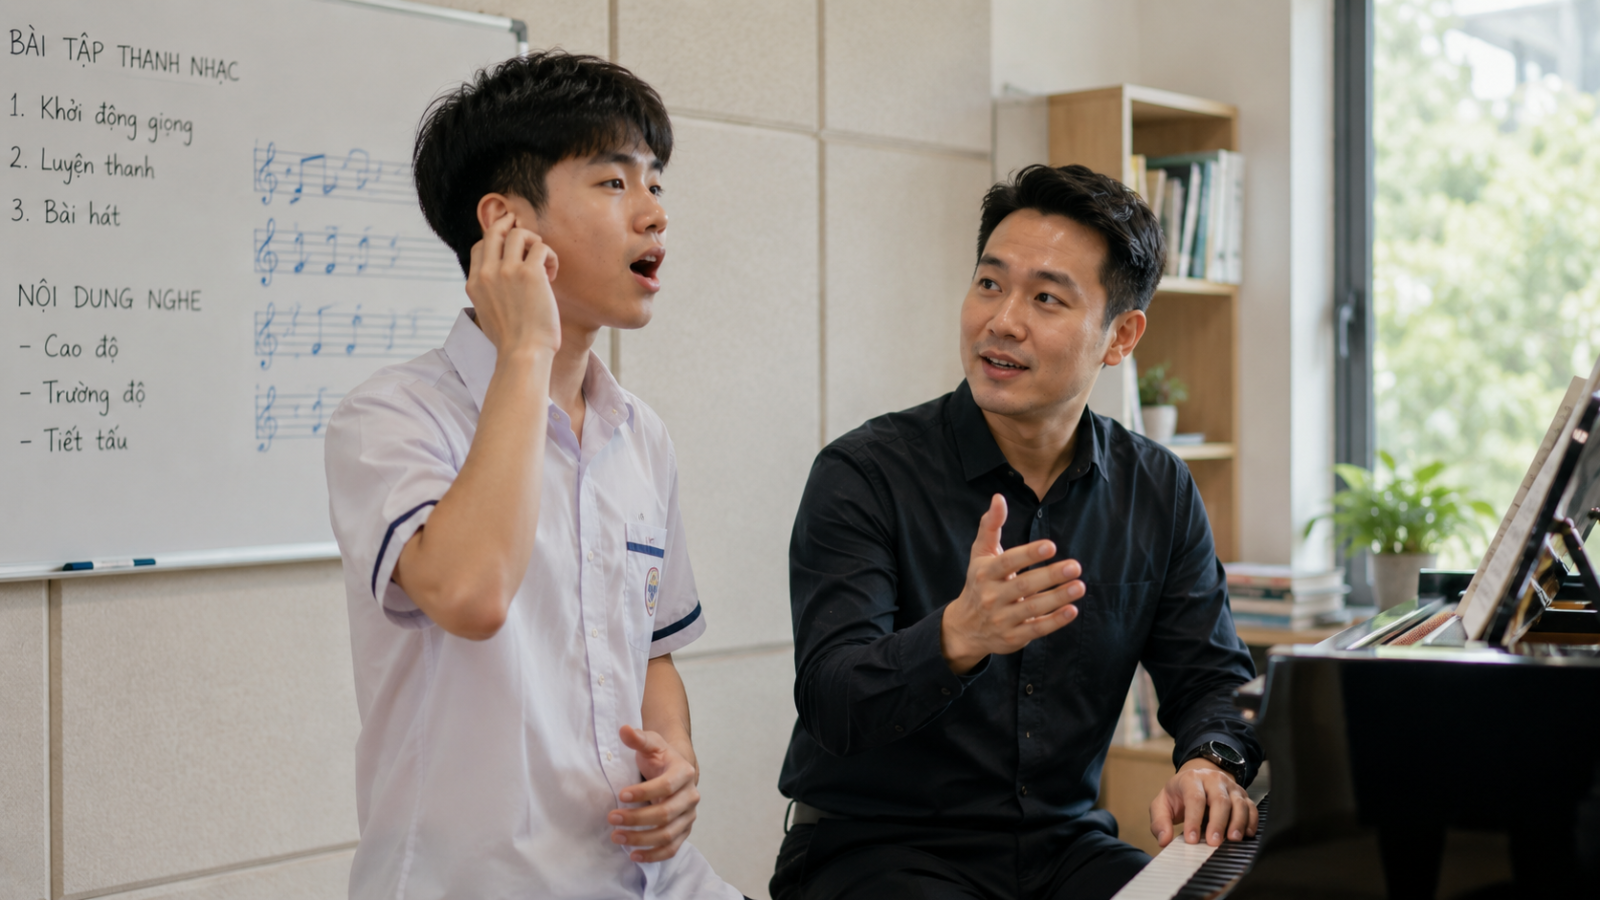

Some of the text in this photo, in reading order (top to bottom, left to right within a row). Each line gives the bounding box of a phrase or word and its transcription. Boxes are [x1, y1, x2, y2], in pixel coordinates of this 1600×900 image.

[8, 23, 240, 85] BÀI TẬP THANH NHẠC
[9, 92, 193, 147] 1. Khởi động giọng
[9, 145, 155, 186] 2. Luyện thanh
[10, 197, 121, 227] 3. Bài hát
[18, 277, 202, 314] NỘI DUNG NGHE
[44, 332, 83, 358] Cao
[94, 334, 119, 364] độ
[42, 379, 110, 417] Trường
[122, 379, 146, 408] độ
[43, 424, 83, 453] Tiết
[95, 424, 128, 452] tấu
